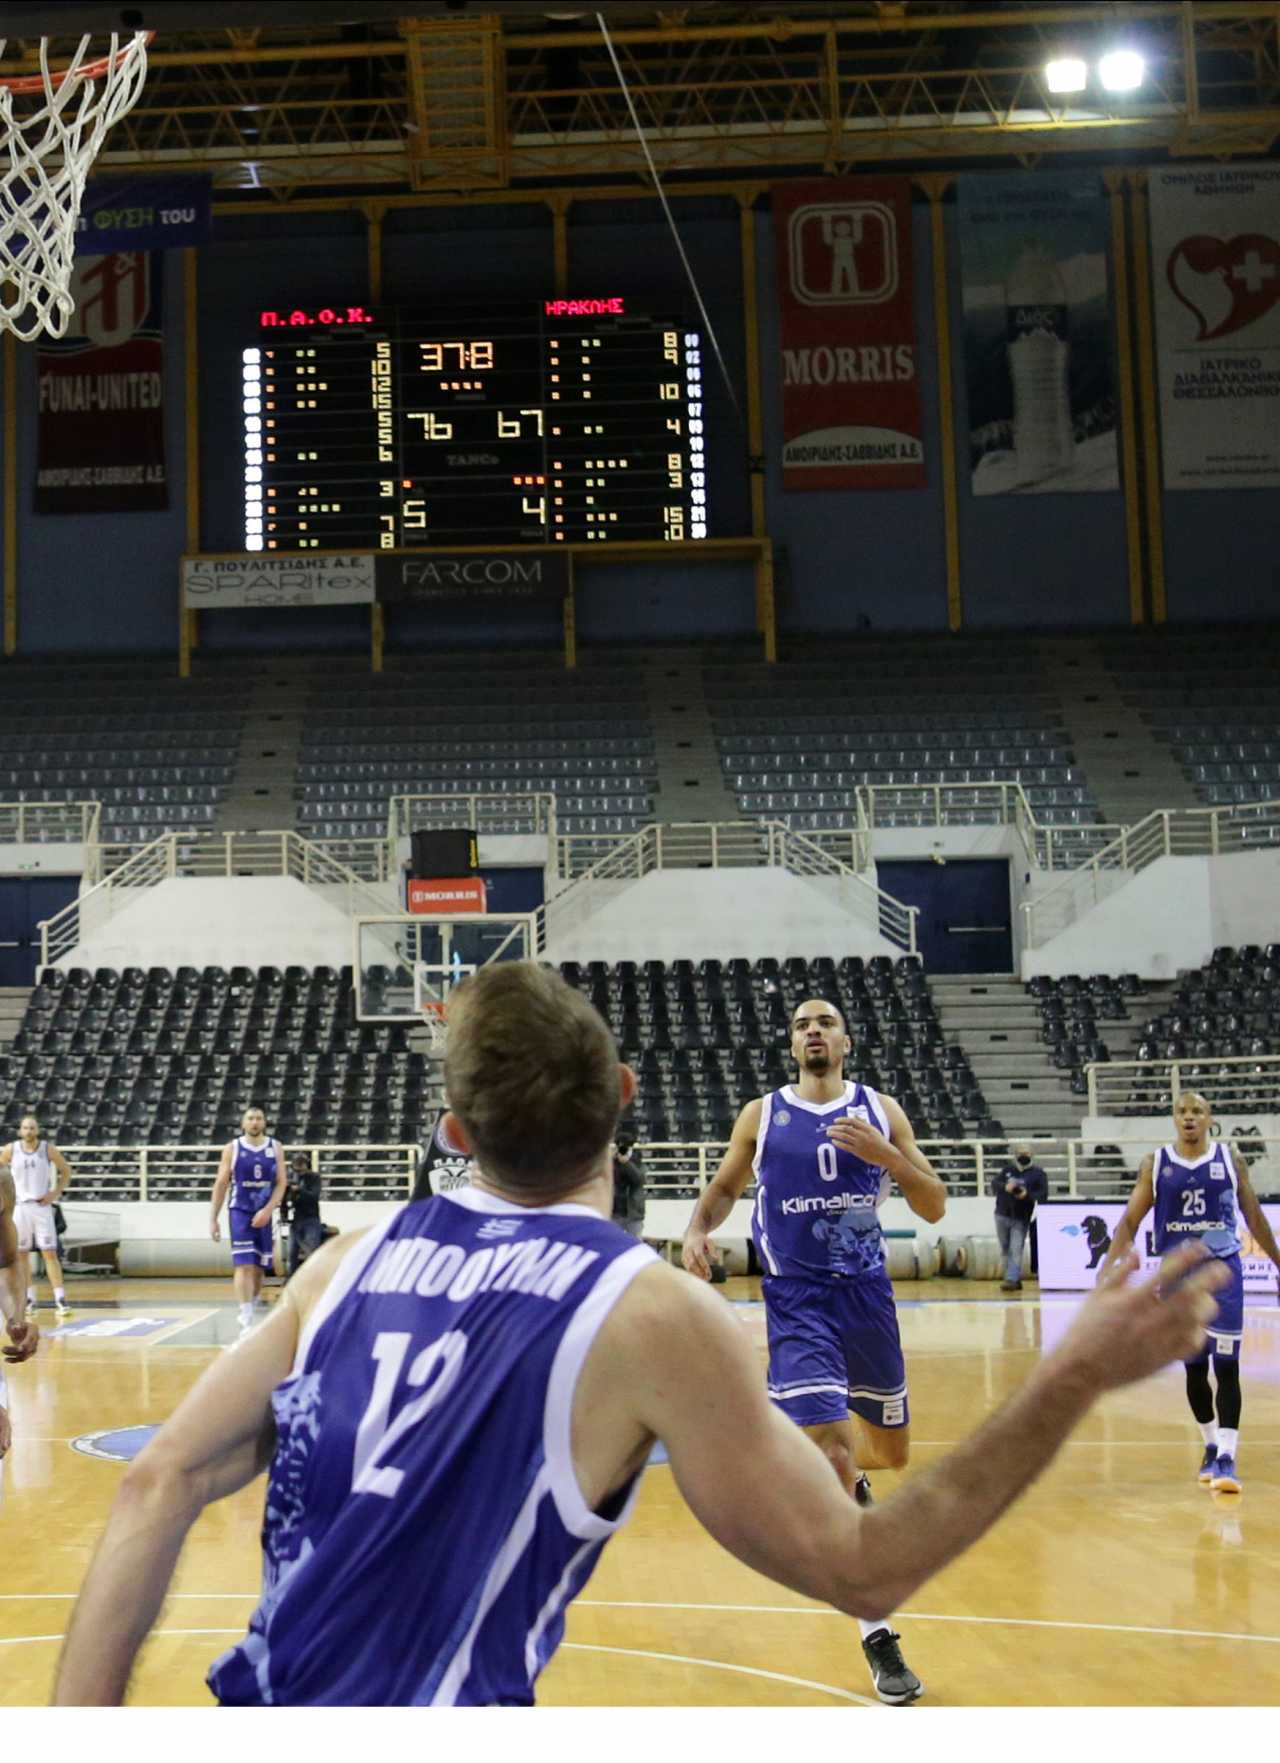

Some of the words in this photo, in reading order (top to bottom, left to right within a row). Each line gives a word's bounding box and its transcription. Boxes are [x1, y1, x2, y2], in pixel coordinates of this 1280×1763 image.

[94, 210, 153, 229] ΦΥΣΗ
[160, 207, 196, 225] του
[783, 346, 915, 386] MORRIS
[497, 410, 543, 438] 67
[403, 500, 426, 528] 5
[522, 497, 545, 524] 4
[402, 559, 542, 585] FARCOM
[817, 1143, 838, 1181] 0
[782, 1192, 875, 1215] Klimallco
[1182, 1189, 1207, 1216] 25
[350, 1329, 469, 1498] 12
